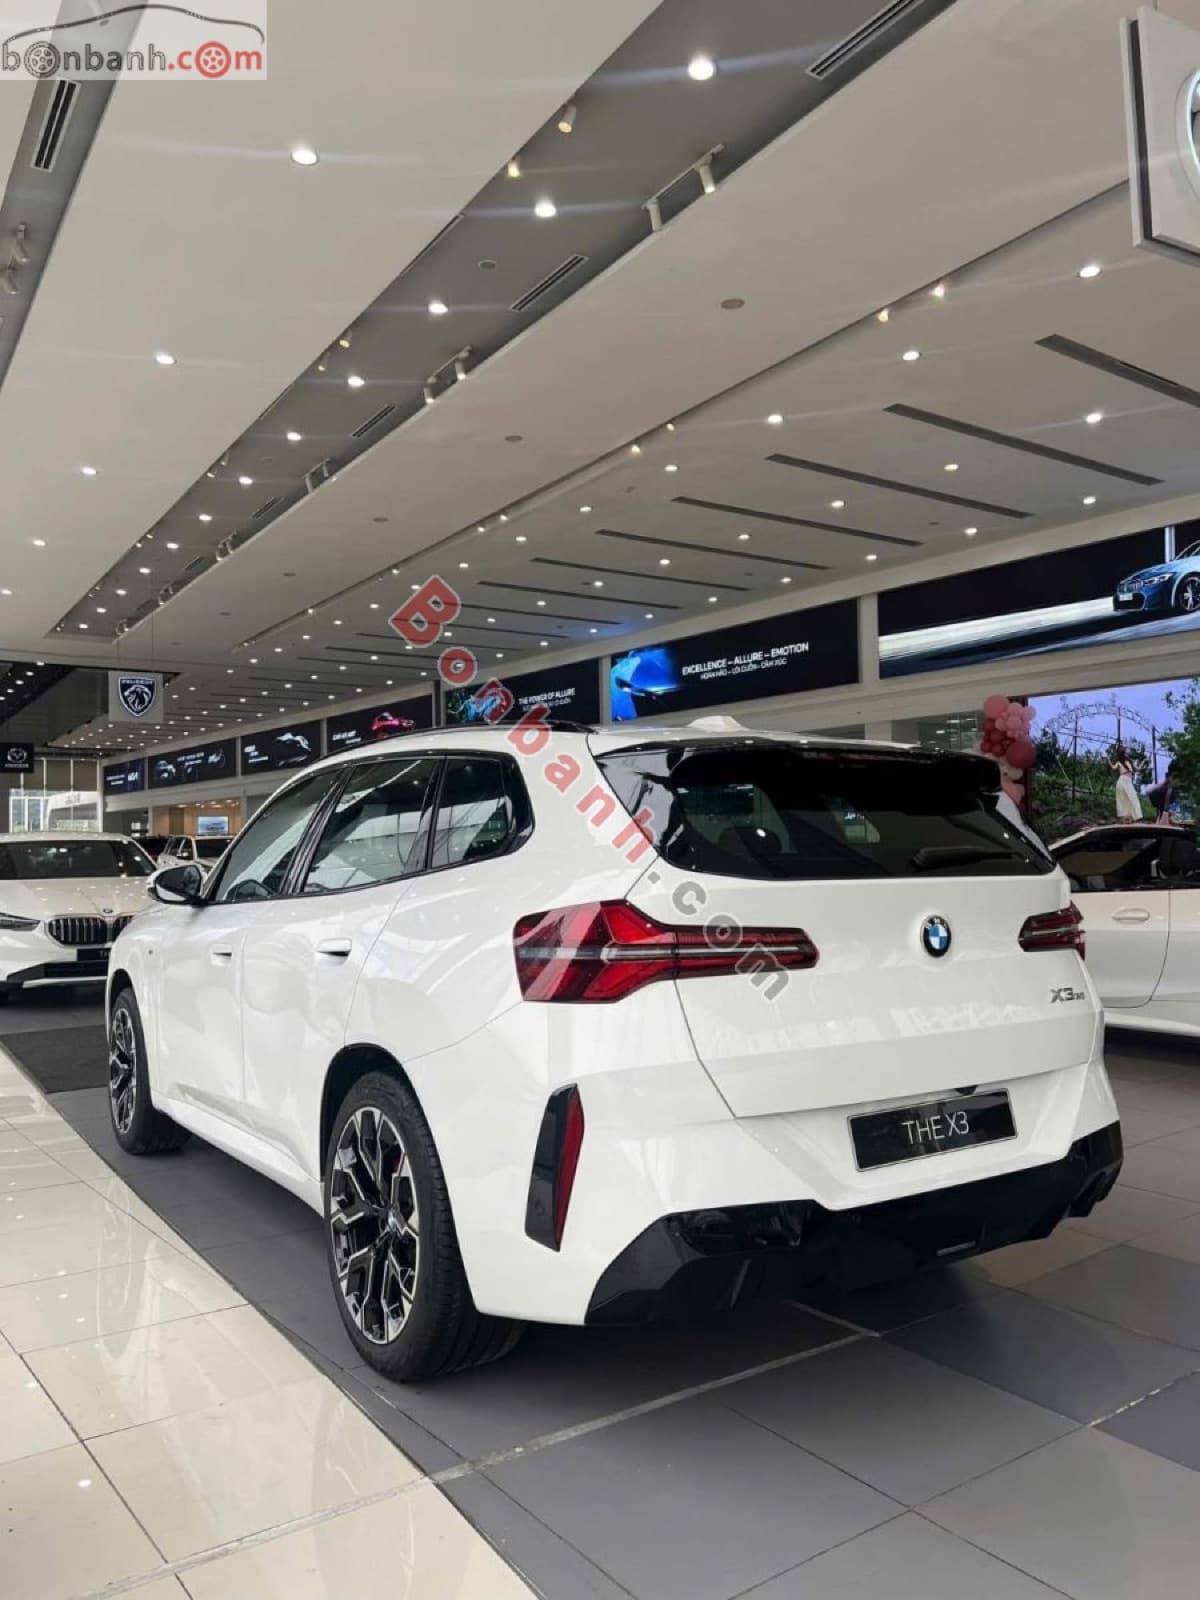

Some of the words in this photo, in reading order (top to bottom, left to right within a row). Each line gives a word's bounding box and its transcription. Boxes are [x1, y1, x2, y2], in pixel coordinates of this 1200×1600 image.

[682, 658, 728, 676] EXCELLENCE
[734, 651, 764, 665] ALLURE
[770, 641, 809, 658] EMOTION
[518, 696, 529, 705] THE
[529, 693, 548, 704] POWER
[548, 691, 556, 700] OF
[556, 687, 576, 698] ALLURE
[901, 1115, 945, 1145] THE
[947, 1111, 970, 1137] X3
